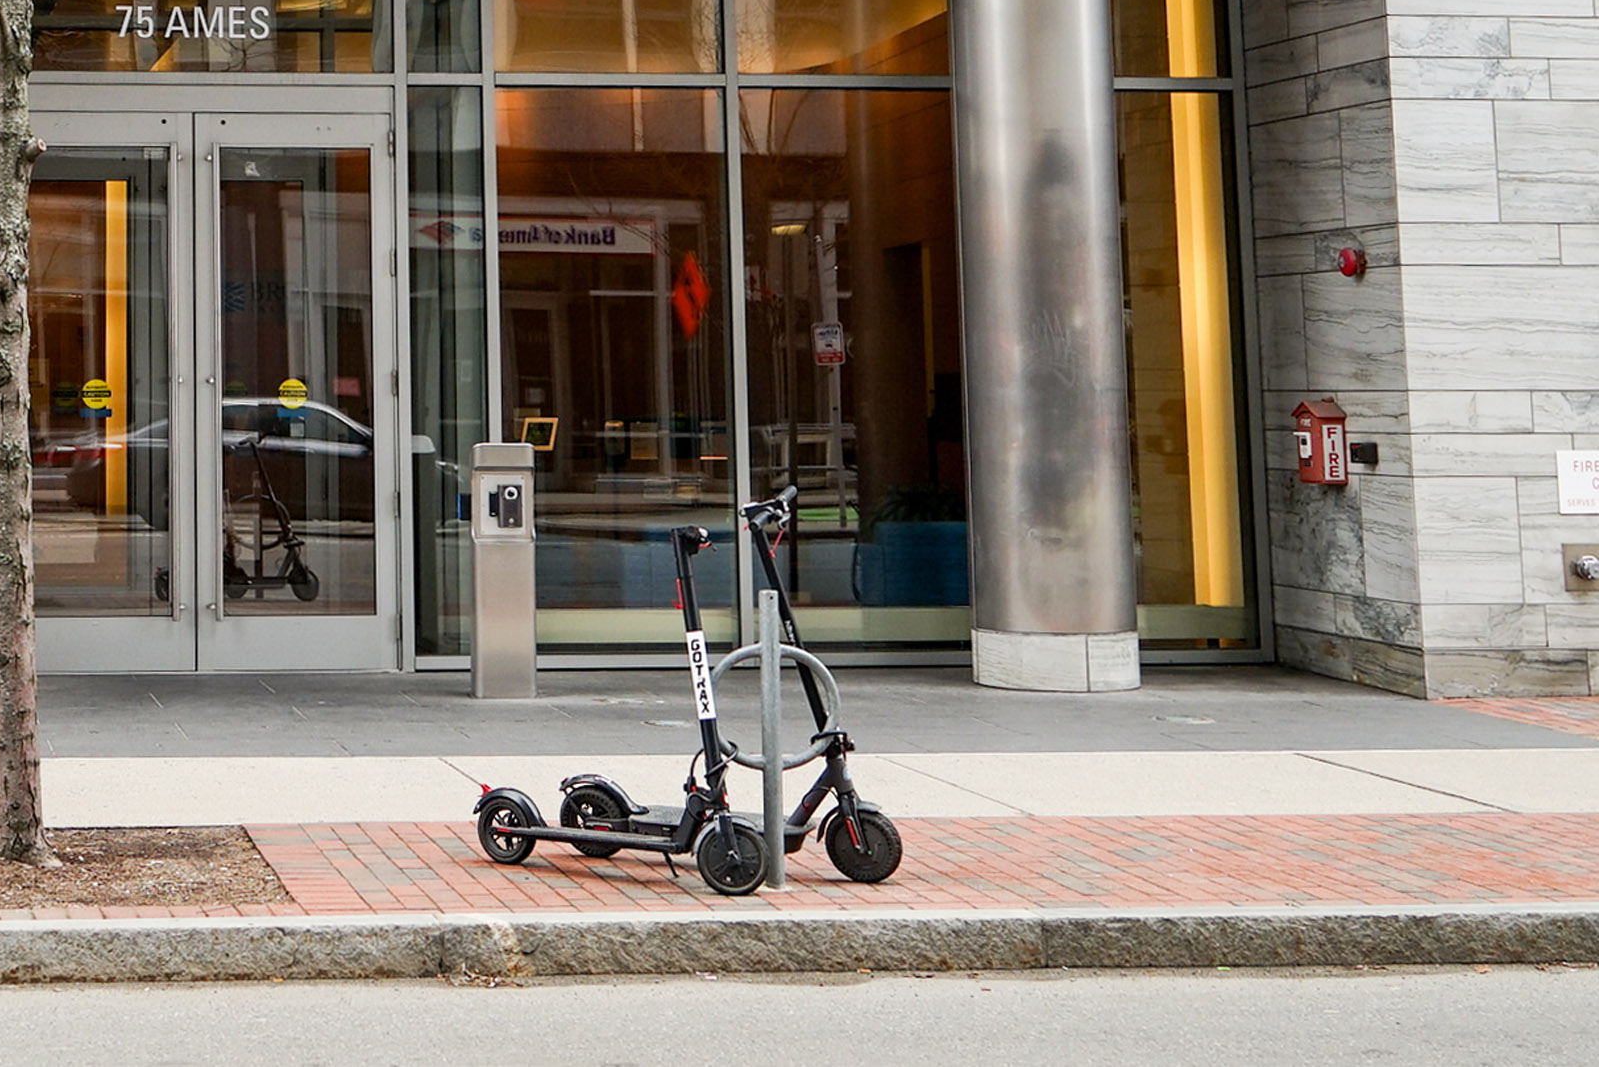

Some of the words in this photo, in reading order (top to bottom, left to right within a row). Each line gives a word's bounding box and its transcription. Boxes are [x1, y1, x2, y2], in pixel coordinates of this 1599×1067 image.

[115, 5, 154, 39] 75
[164, 5, 270, 40] AMES
[1326, 427, 1340, 478] FIRE
[1573, 460, 1599, 473] FIRE
[690, 639, 710, 714] GOTRAX
